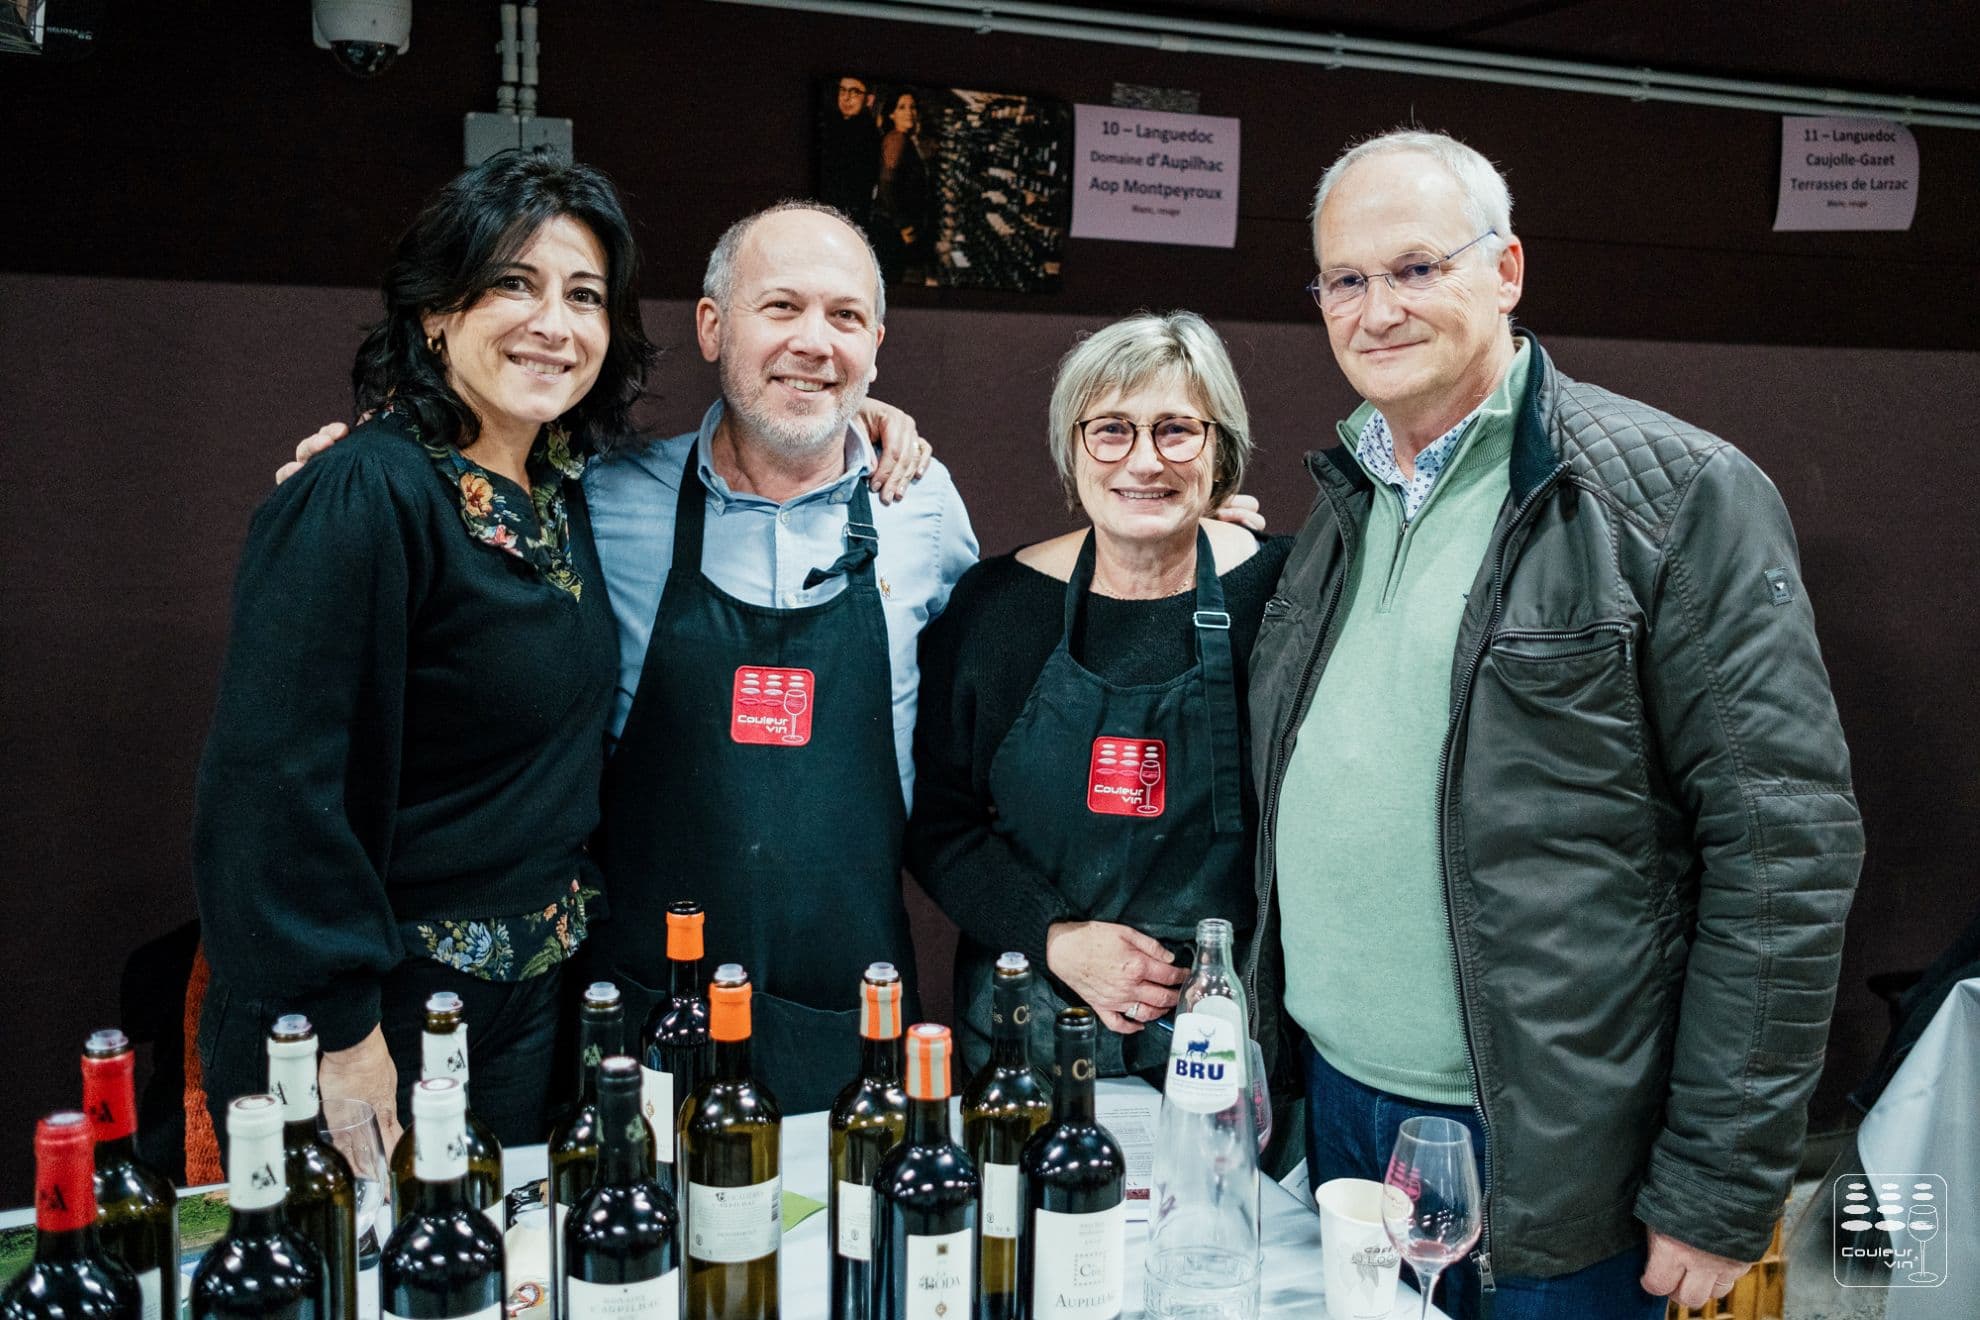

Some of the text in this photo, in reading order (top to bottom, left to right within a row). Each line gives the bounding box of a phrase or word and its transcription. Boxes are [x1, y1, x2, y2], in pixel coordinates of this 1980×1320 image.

[1102, 121, 1120, 136] 10
[1136, 124, 1214, 144] Languedoc
[1804, 129, 1818, 142] 11
[1833, 130, 1896, 144] Languedoc
[1090, 150, 1144, 166] Domaine
[1806, 153, 1895, 169] Caujolle-Gazet
[1089, 176, 1222, 201] Aop Montpeyroux
[1790, 178, 1909, 191] Terrasses de Larzac
[737, 714, 788, 726] Couleur
[766, 725, 787, 734] vin
[1094, 784, 1144, 796] Couleur
[1121, 795, 1143, 804] vin
[1176, 1058, 1225, 1081] BRU
